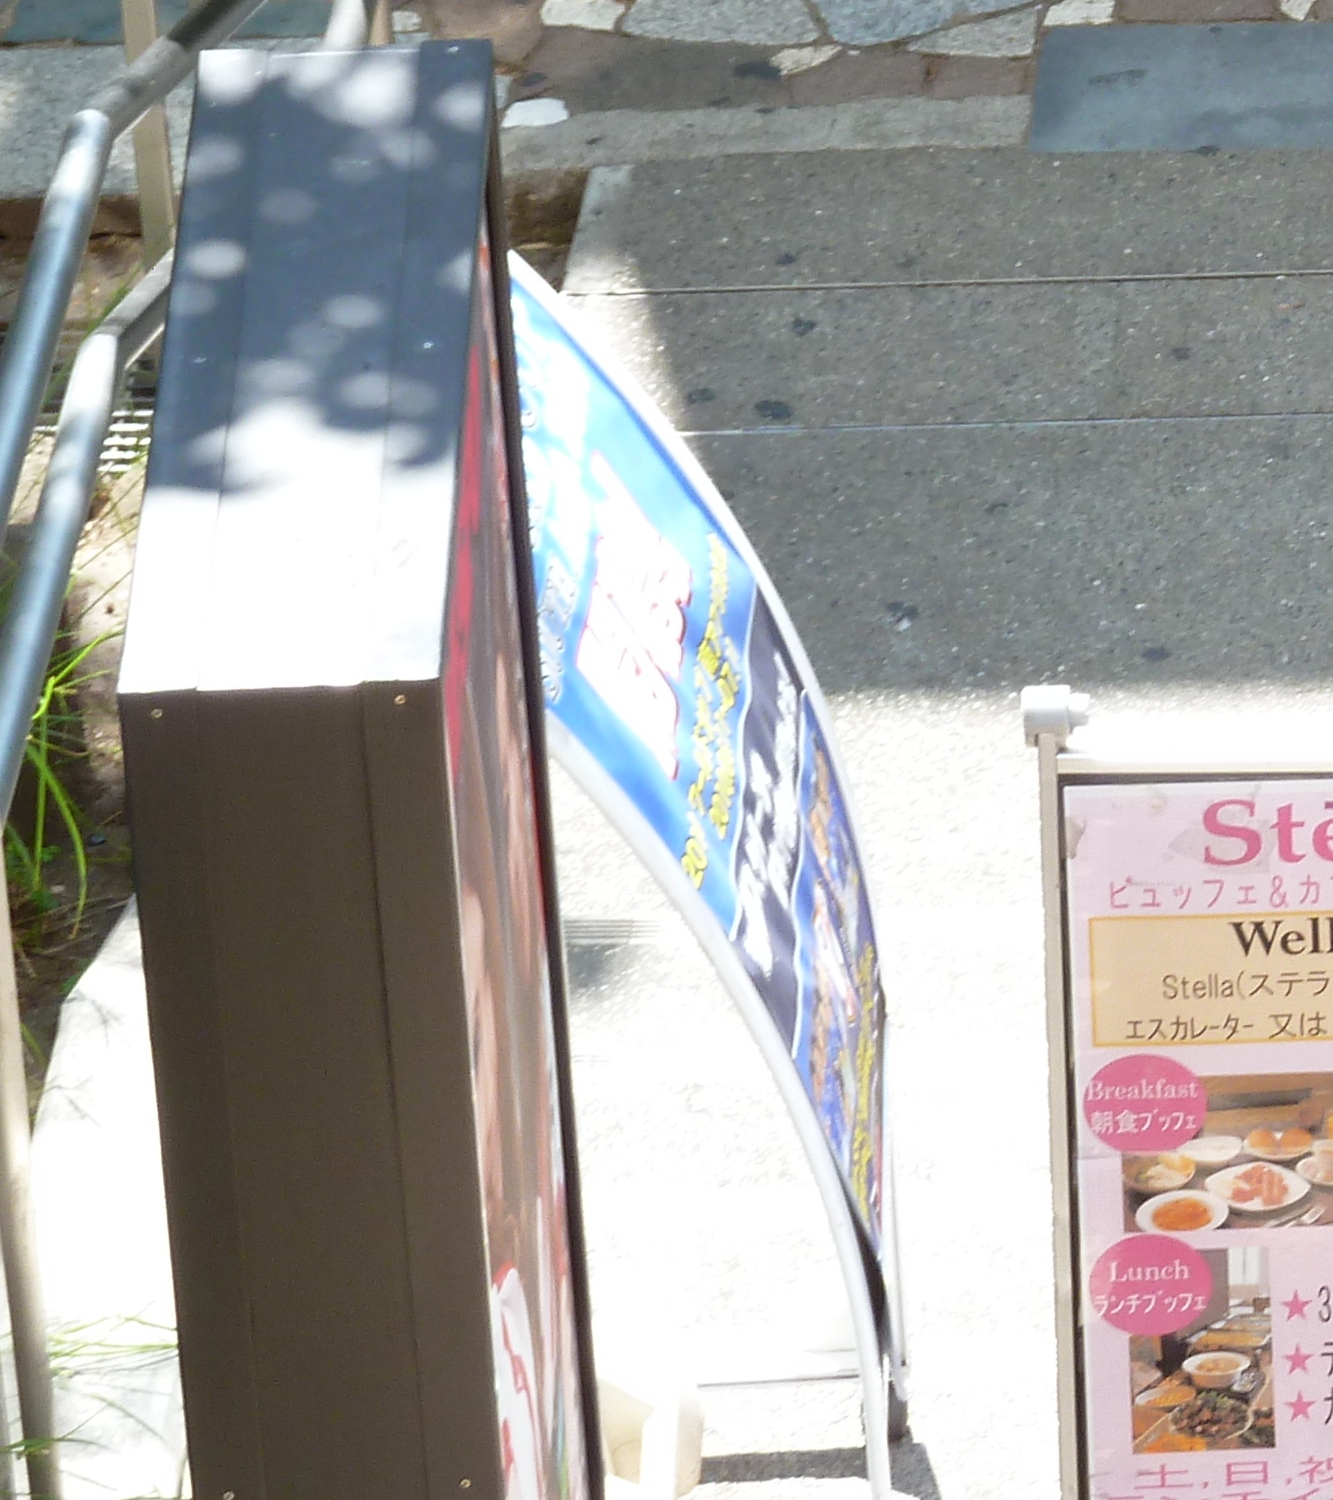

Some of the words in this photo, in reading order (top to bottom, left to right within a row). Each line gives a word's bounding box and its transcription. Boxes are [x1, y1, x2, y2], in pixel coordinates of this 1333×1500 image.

[1268, 1010, 1328, 1040] 又は
[1086, 1077, 1200, 1101] Breakfast
[1108, 1258, 1191, 1284] Lunch
[1094, 1289, 1207, 1317] ランチブッフェ
